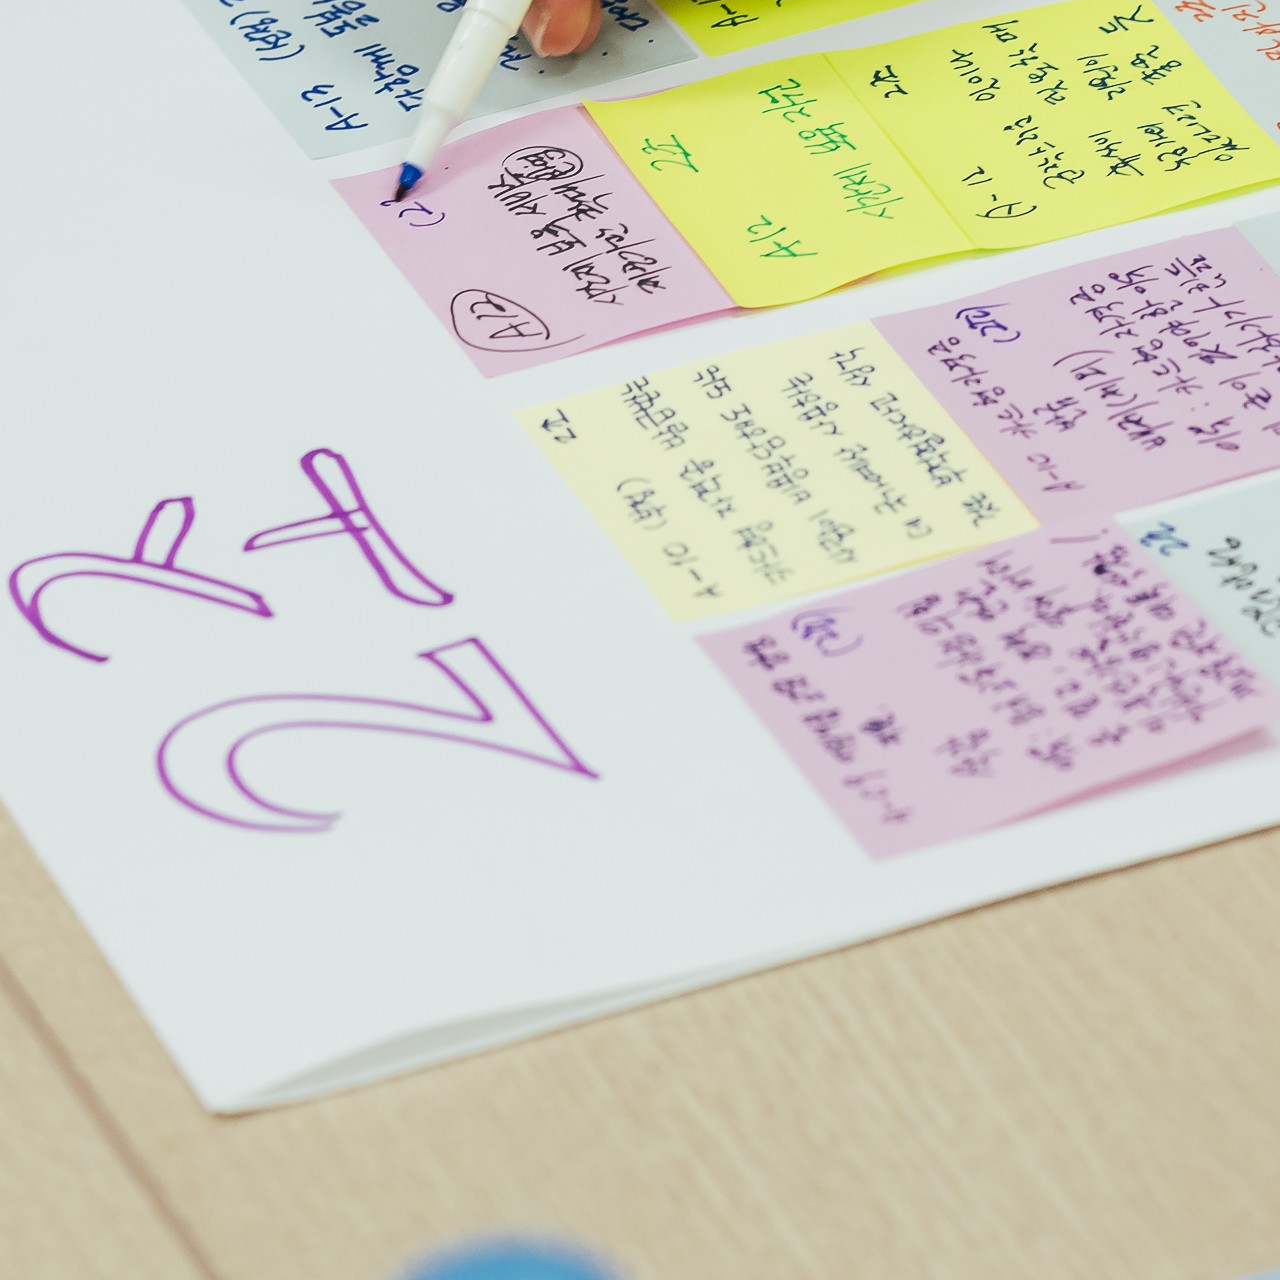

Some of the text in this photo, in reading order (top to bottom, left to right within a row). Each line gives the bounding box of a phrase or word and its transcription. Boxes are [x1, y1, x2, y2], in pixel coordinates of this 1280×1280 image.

[981, 19, 1019, 44] 때
[300, 83, 369, 131] A-13
[757, 77, 818, 124] 지원
[641, 133, 700, 174] 2조
[797, 121, 857, 156] 보육
[832, 162, 905, 220] 시간제
[829, 347, 876, 387] 생각
[8, 446, 602, 836] 2조
